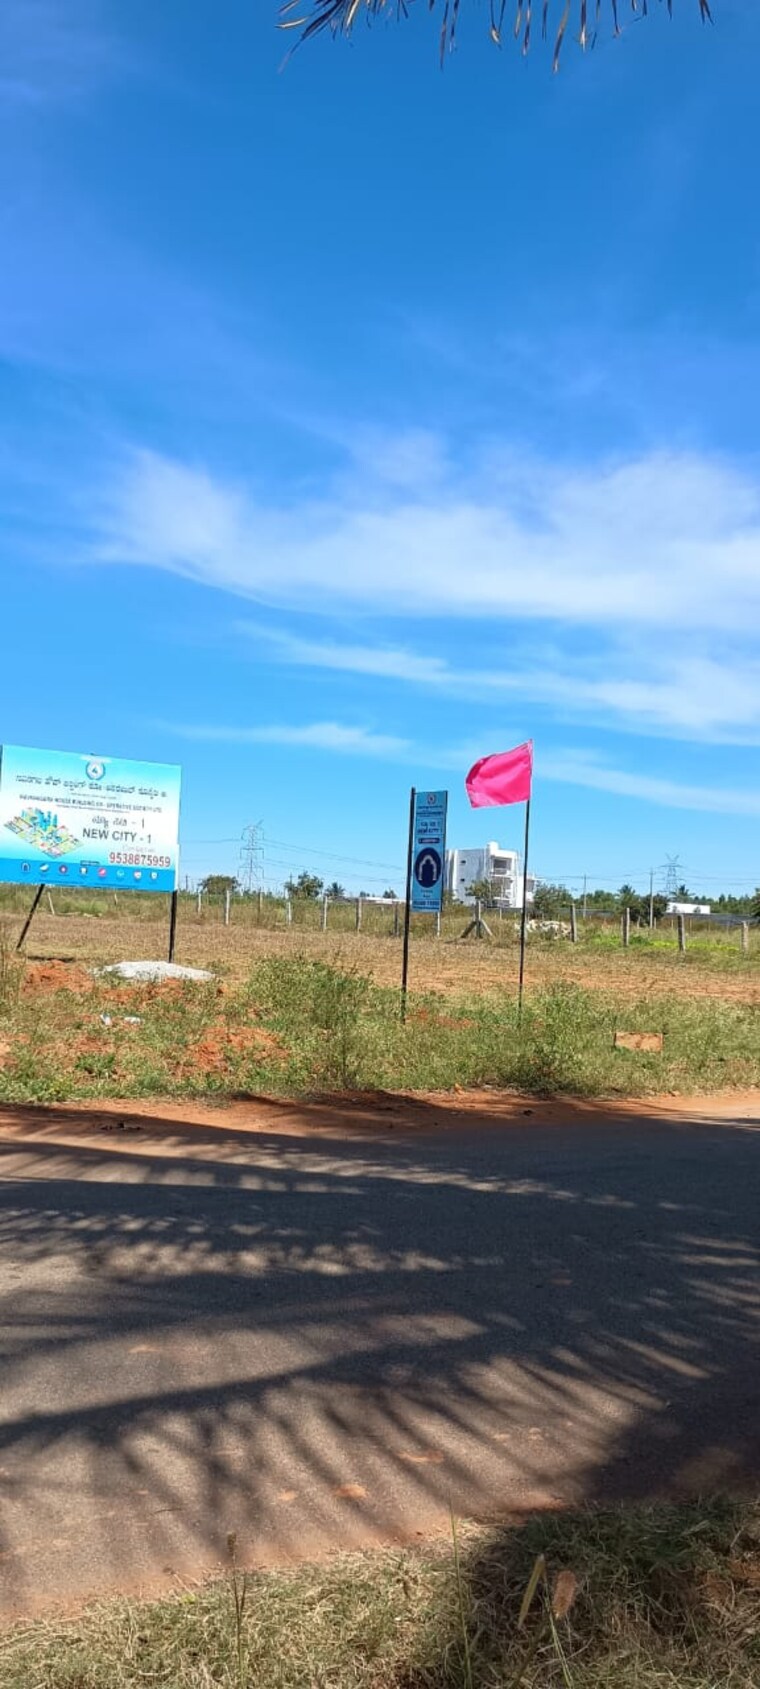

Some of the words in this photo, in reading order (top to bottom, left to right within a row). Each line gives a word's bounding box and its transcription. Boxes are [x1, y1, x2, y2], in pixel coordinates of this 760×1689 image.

[82, 828, 109, 840] NEW
[112, 830, 137, 843] CITY
[147, 833, 151, 844] 1
